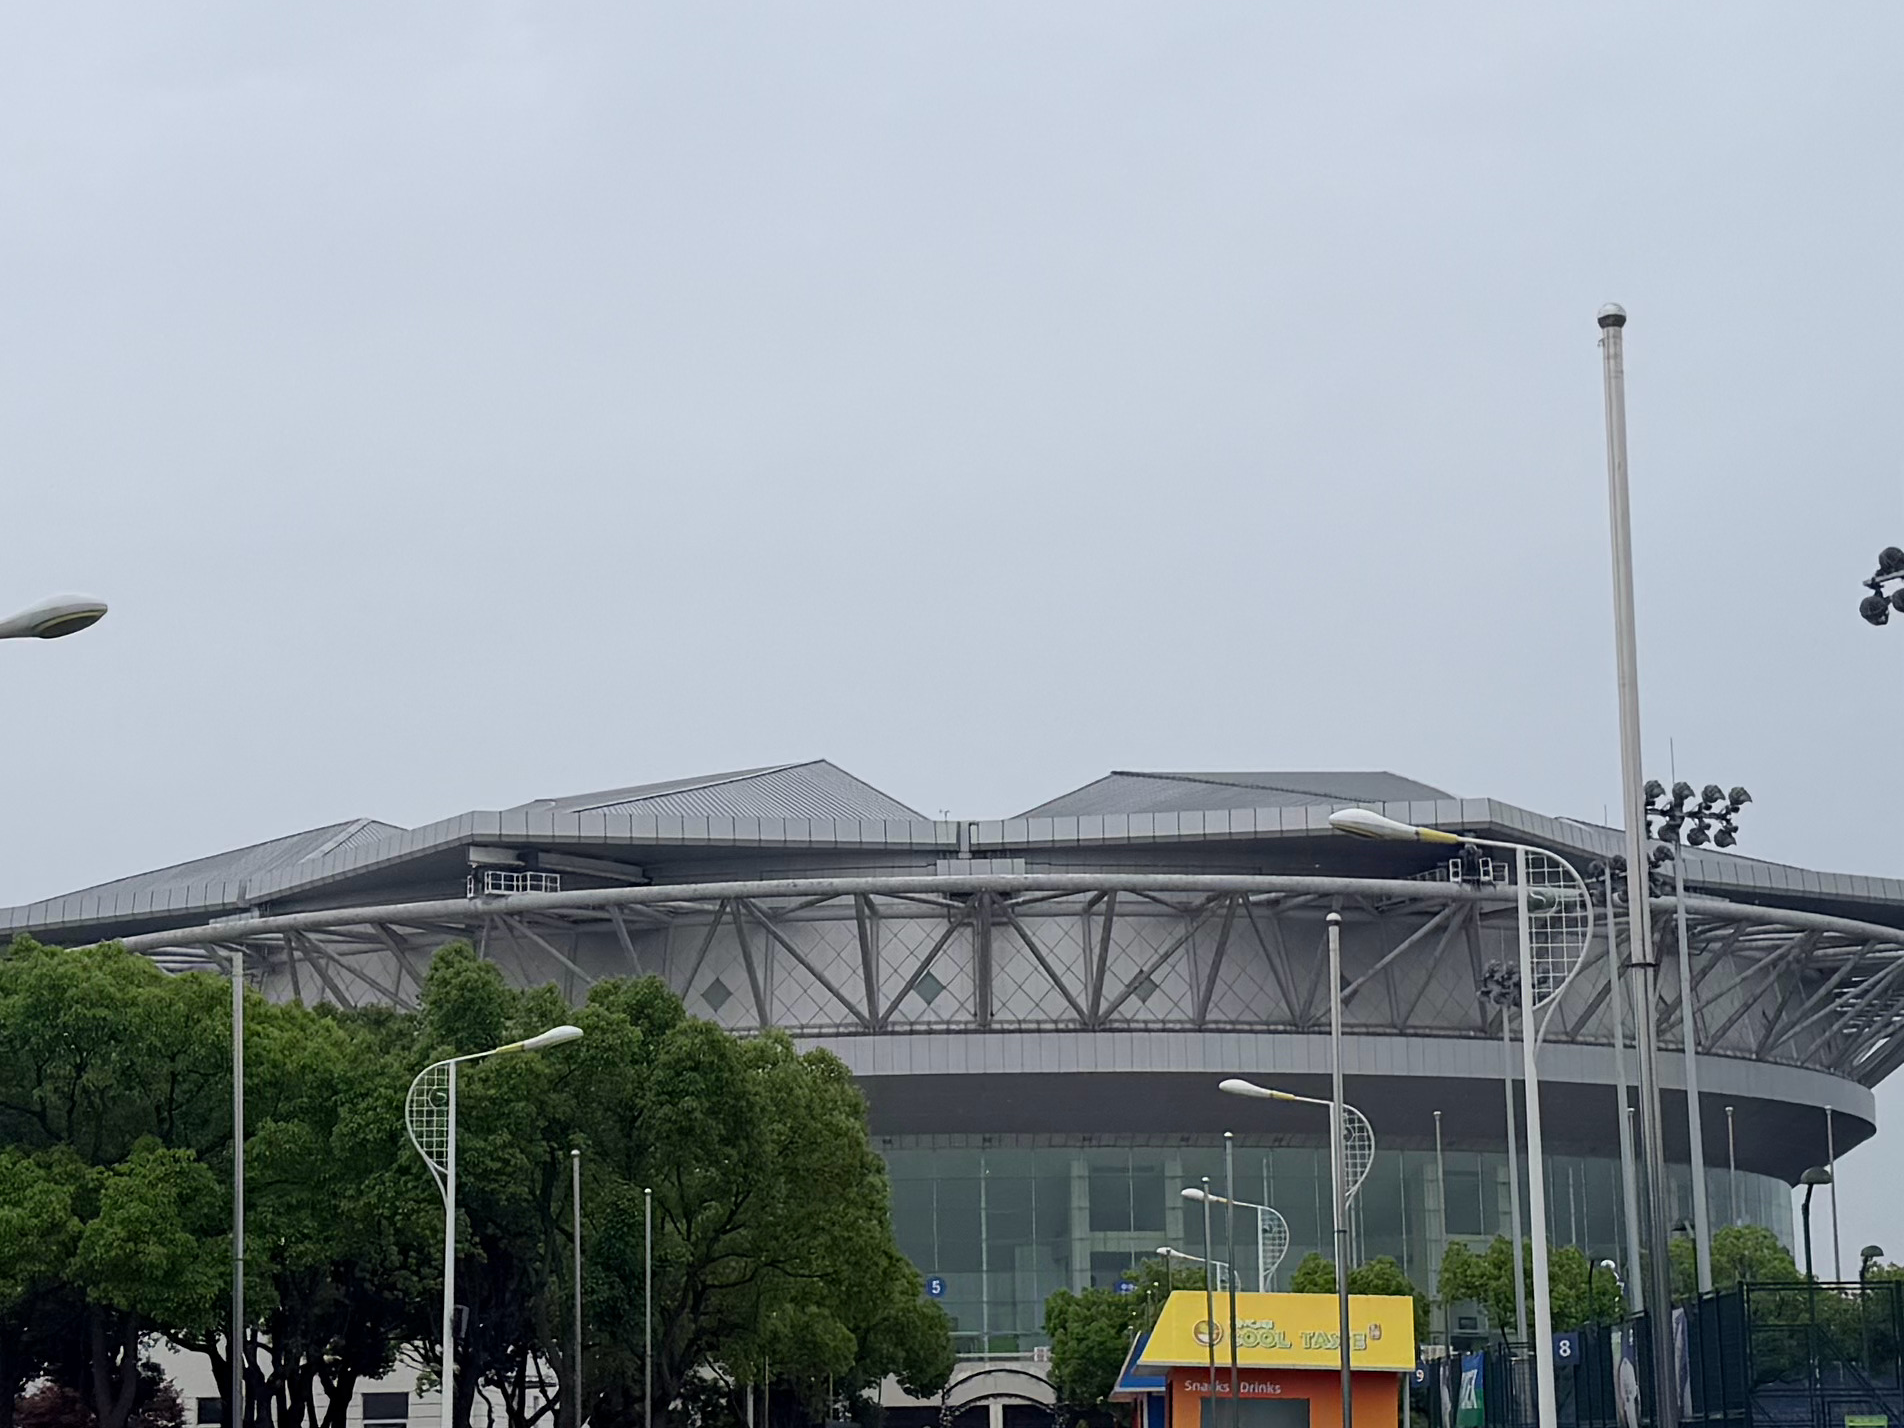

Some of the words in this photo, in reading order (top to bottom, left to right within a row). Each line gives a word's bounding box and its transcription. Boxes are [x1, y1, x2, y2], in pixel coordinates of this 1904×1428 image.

[931, 1279, 941, 1294] 5
[1299, 1331, 1367, 1351] TASE
[1559, 1340, 1571, 1357] 8
[1415, 1369, 1425, 1383] 9
[1184, 1380, 1230, 1393] Snaks
[1240, 1381, 1282, 1395] Drinks
